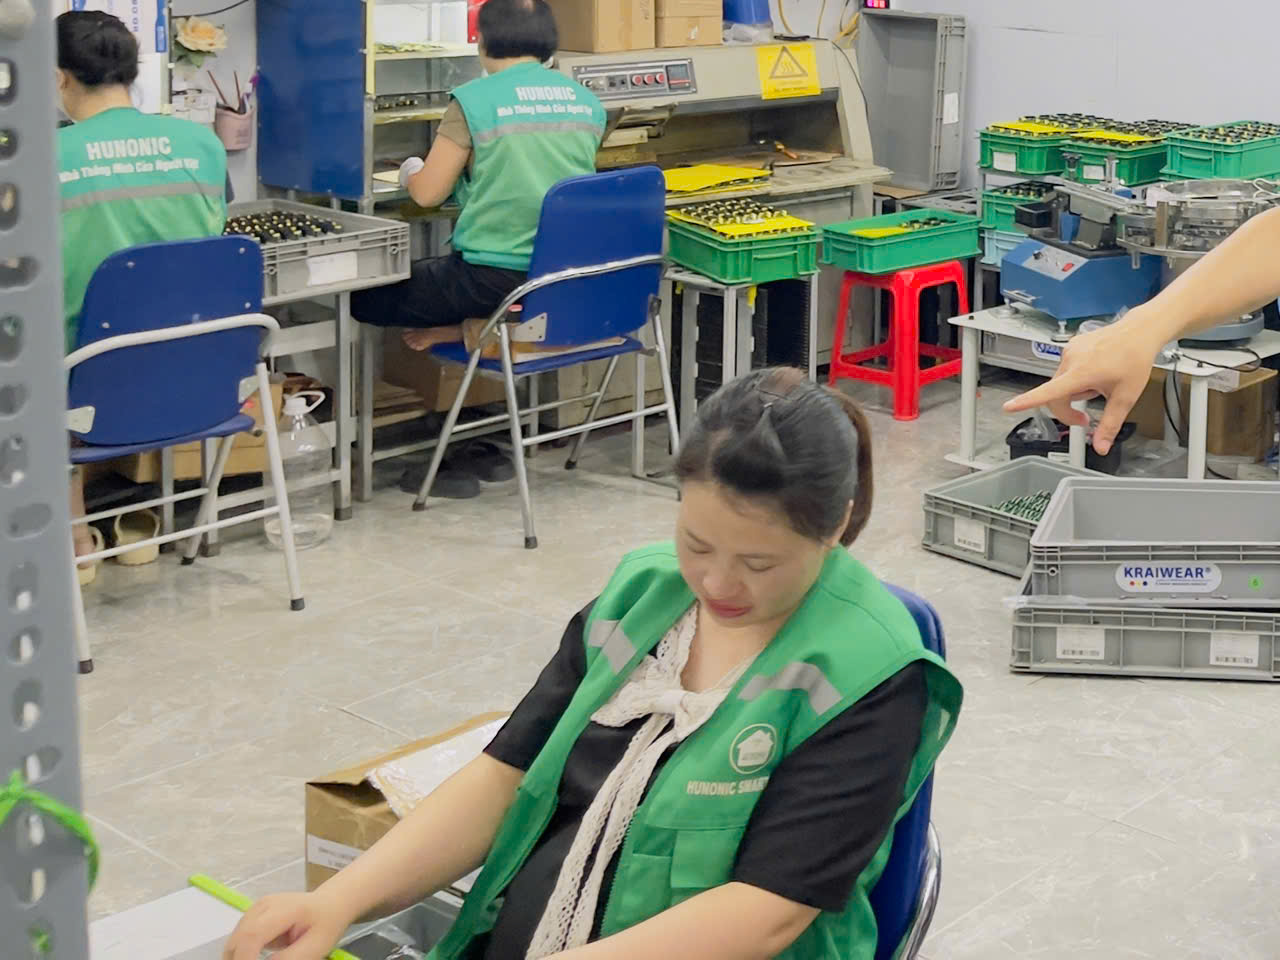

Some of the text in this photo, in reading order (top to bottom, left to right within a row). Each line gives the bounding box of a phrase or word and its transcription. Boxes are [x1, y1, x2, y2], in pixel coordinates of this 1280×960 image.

[515, 85, 577, 101] HUNONIC
[86, 136, 172, 161] HUNONIC
[687, 780, 736, 796] HUNONIC
